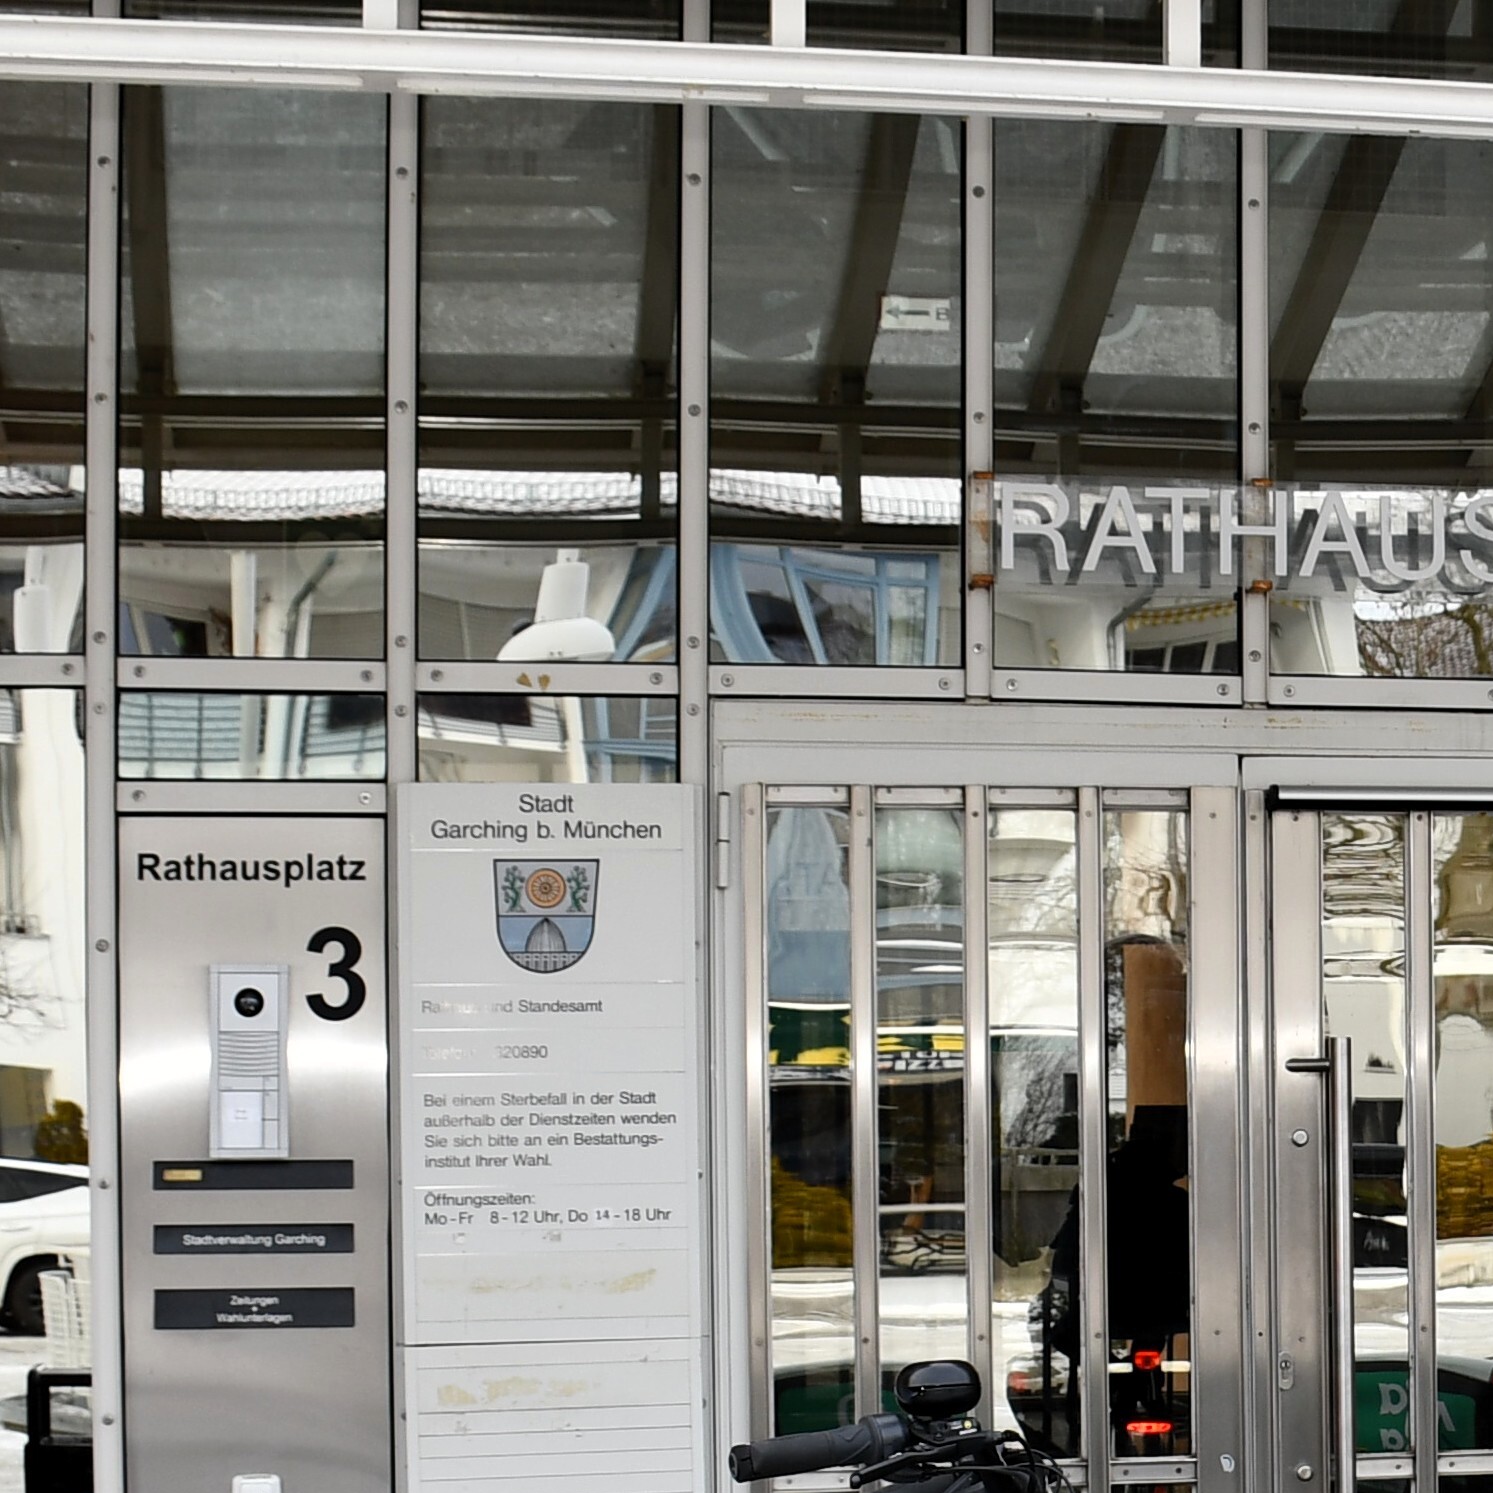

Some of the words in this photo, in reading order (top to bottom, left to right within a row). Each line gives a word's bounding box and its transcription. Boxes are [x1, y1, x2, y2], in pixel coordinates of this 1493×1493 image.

[518, 793, 575, 815] Stadt
[430, 819, 528, 843] Garching
[536, 819, 556, 840] b.
[562, 818, 662, 840] München
[136, 852, 367, 889] Rathausplatz
[305, 925, 367, 1022] 3
[518, 998, 604, 1013] Standesamt
[424, 1093, 447, 1107] Bei
[452, 1094, 496, 1107] einem
[500, 1092, 567, 1107] Sterbefall
[572, 1092, 585, 1105] in
[590, 1091, 614, 1105] der
[618, 1090, 657, 1105] Stadt
[424, 1114, 496, 1128] außerhalb
[500, 1113, 524, 1127] der
[529, 1111, 615, 1127] Dienstzeiten
[620, 1111, 677, 1125] wenden
[424, 1134, 447, 1148] Sie
[453, 1134, 482, 1148] sich
[488, 1133, 519, 1148] bitte
[524, 1135, 542, 1147] an
[547, 1133, 568, 1147] ein
[573, 1132, 664, 1148] Bestattungs-
[424, 1154, 471, 1168] institut
[475, 1154, 509, 1168] Ihrer
[424, 1191, 536, 1209] Öffnungszeiten:
[533, 1209, 563, 1225] Uhr,
[567, 1208, 589, 1223] Do
[645, 1207, 672, 1222] Uhr
[182, 1233, 273, 1247] Stadtverwaltung
[274, 1233, 326, 1247] Garching
[229, 1294, 280, 1308] Zeitungen
